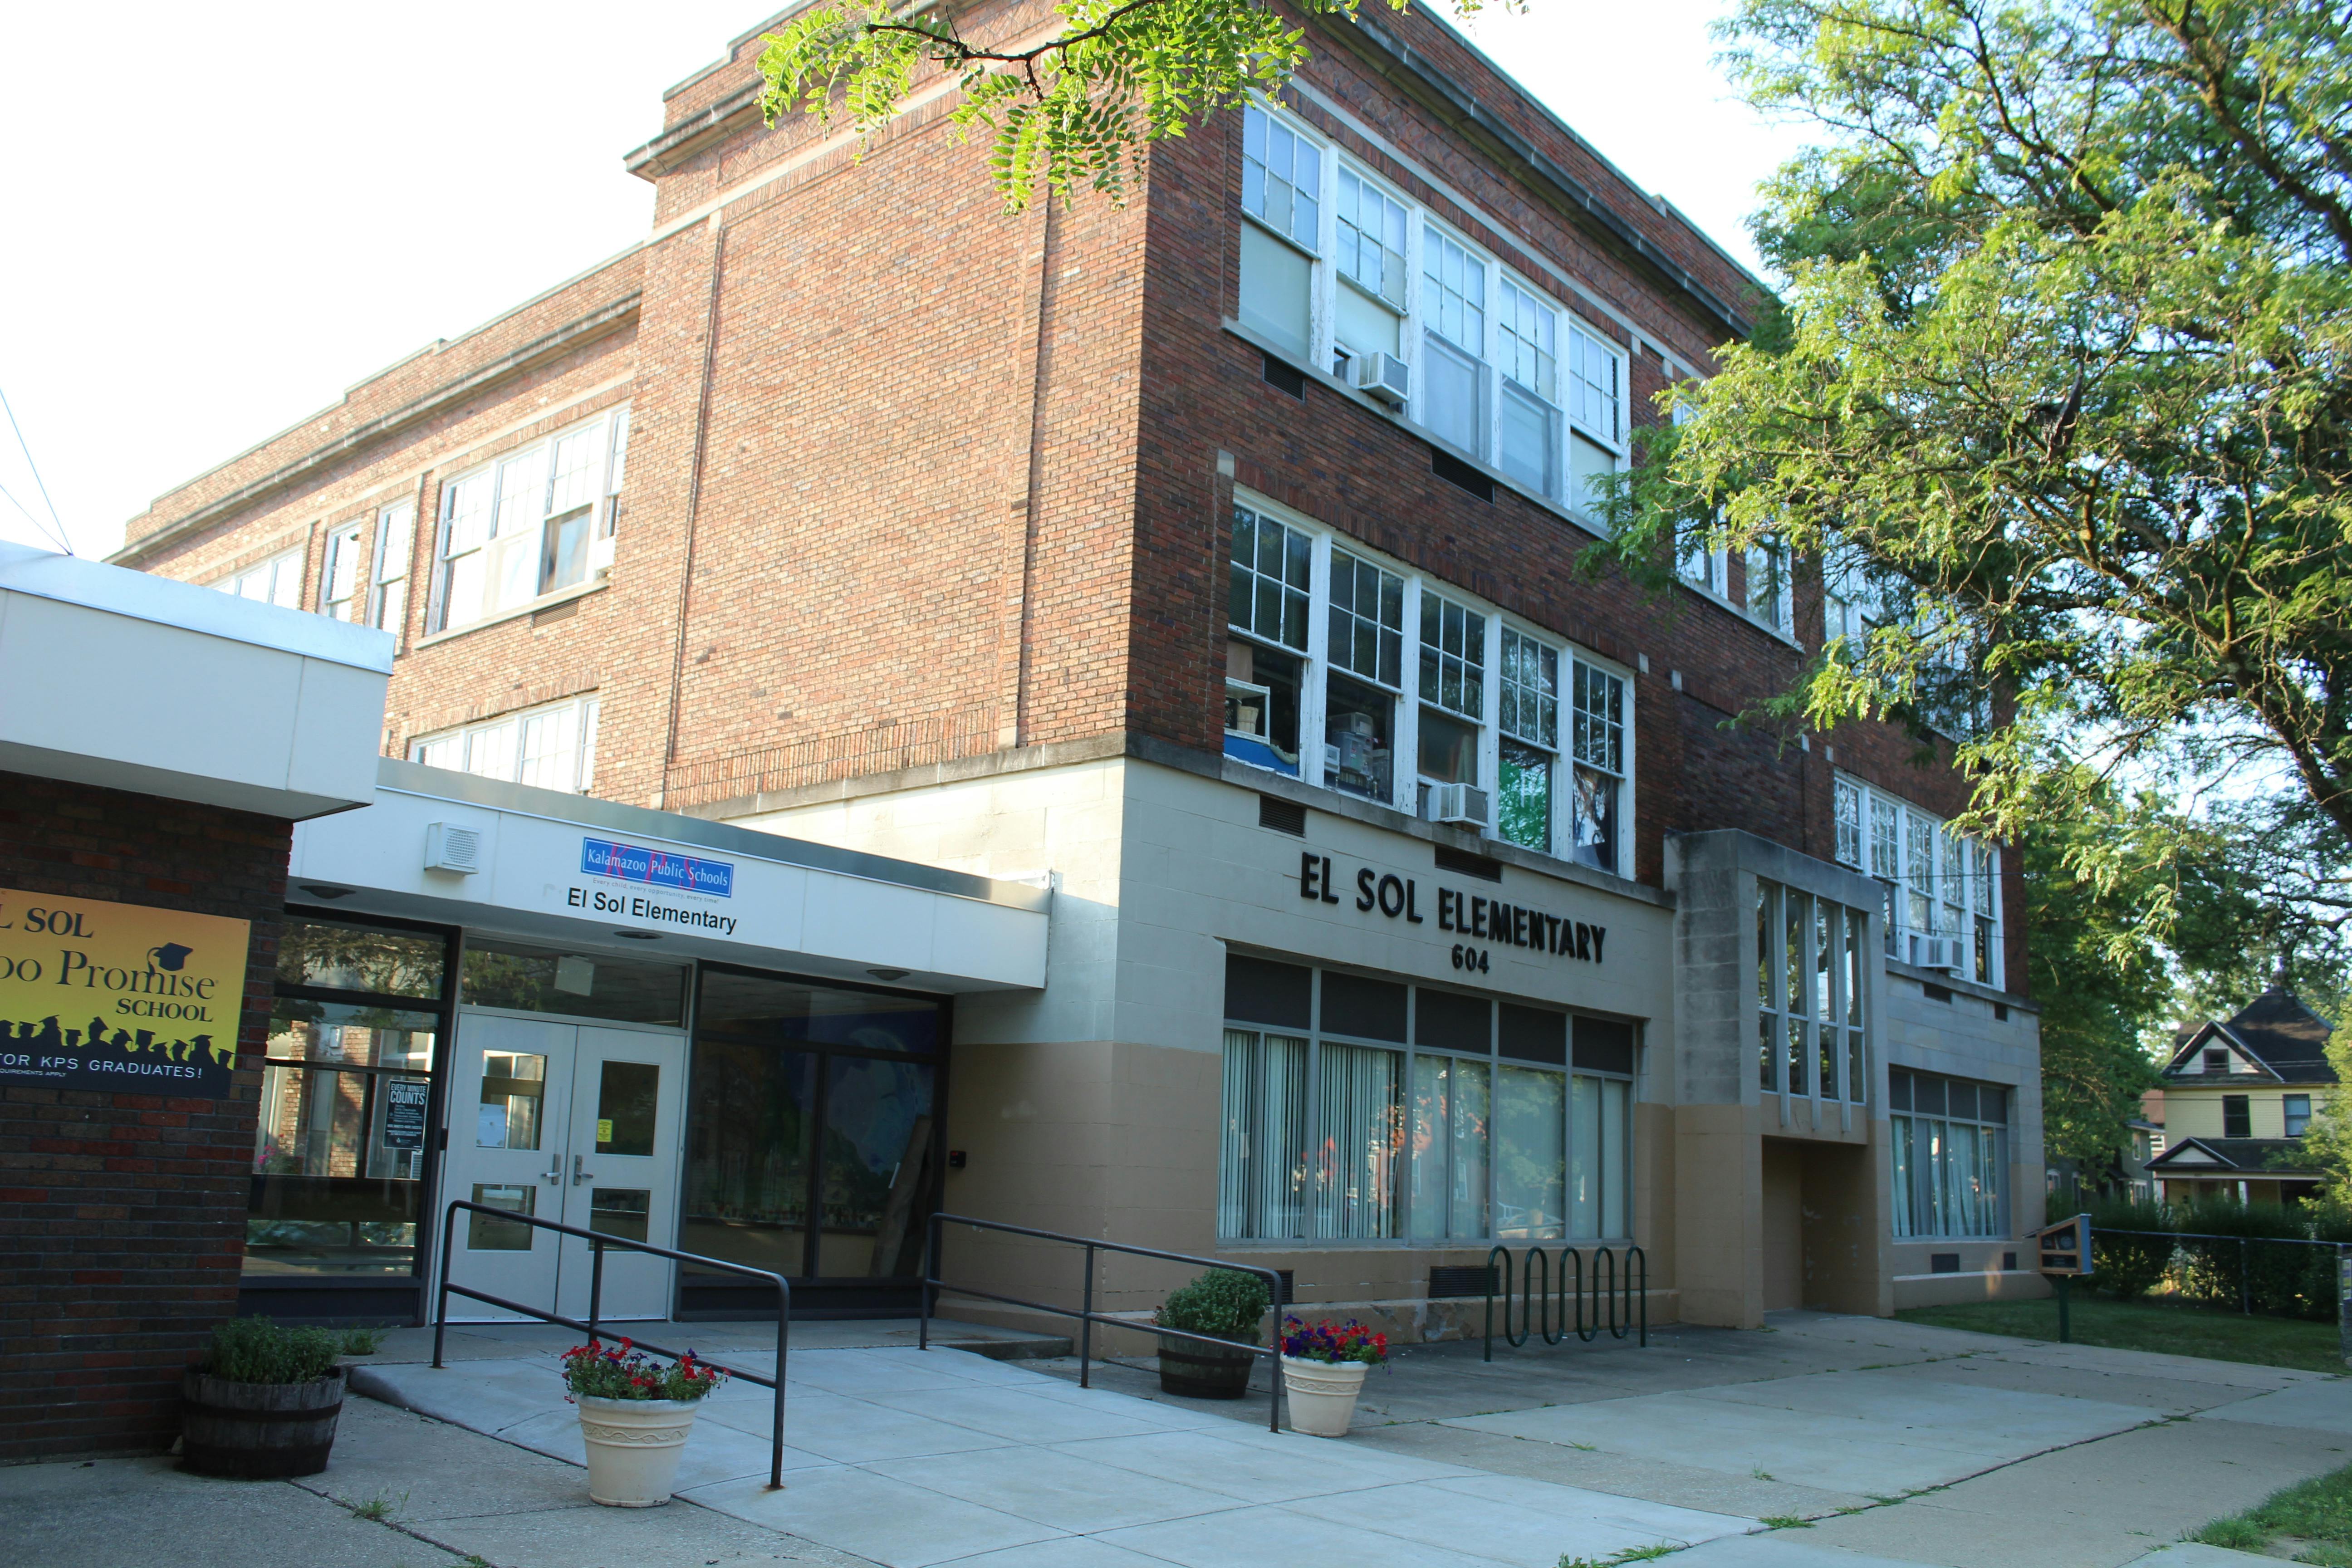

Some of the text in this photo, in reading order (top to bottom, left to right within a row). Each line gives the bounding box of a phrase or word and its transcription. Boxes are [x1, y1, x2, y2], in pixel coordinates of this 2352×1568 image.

[588, 849, 728, 886] Kalamazoo Public Schools
[593, 877, 609, 886] Every
[568, 887, 736, 935] El Sol Elementary
[1301, 851, 1607, 963] EL SOL ELEMENTARY
[24, 907, 94, 938] SOL
[1452, 944, 1490, 974] 604
[54, 949, 215, 1000] Promise
[116, 998, 214, 1022] SCHOOL
[41, 1056, 78, 1069] KPS
[89, 1059, 202, 1078] GRADUATES!
[390, 1090, 426, 1105] COUNTS
[407, 1084, 426, 1093] MINUTE
